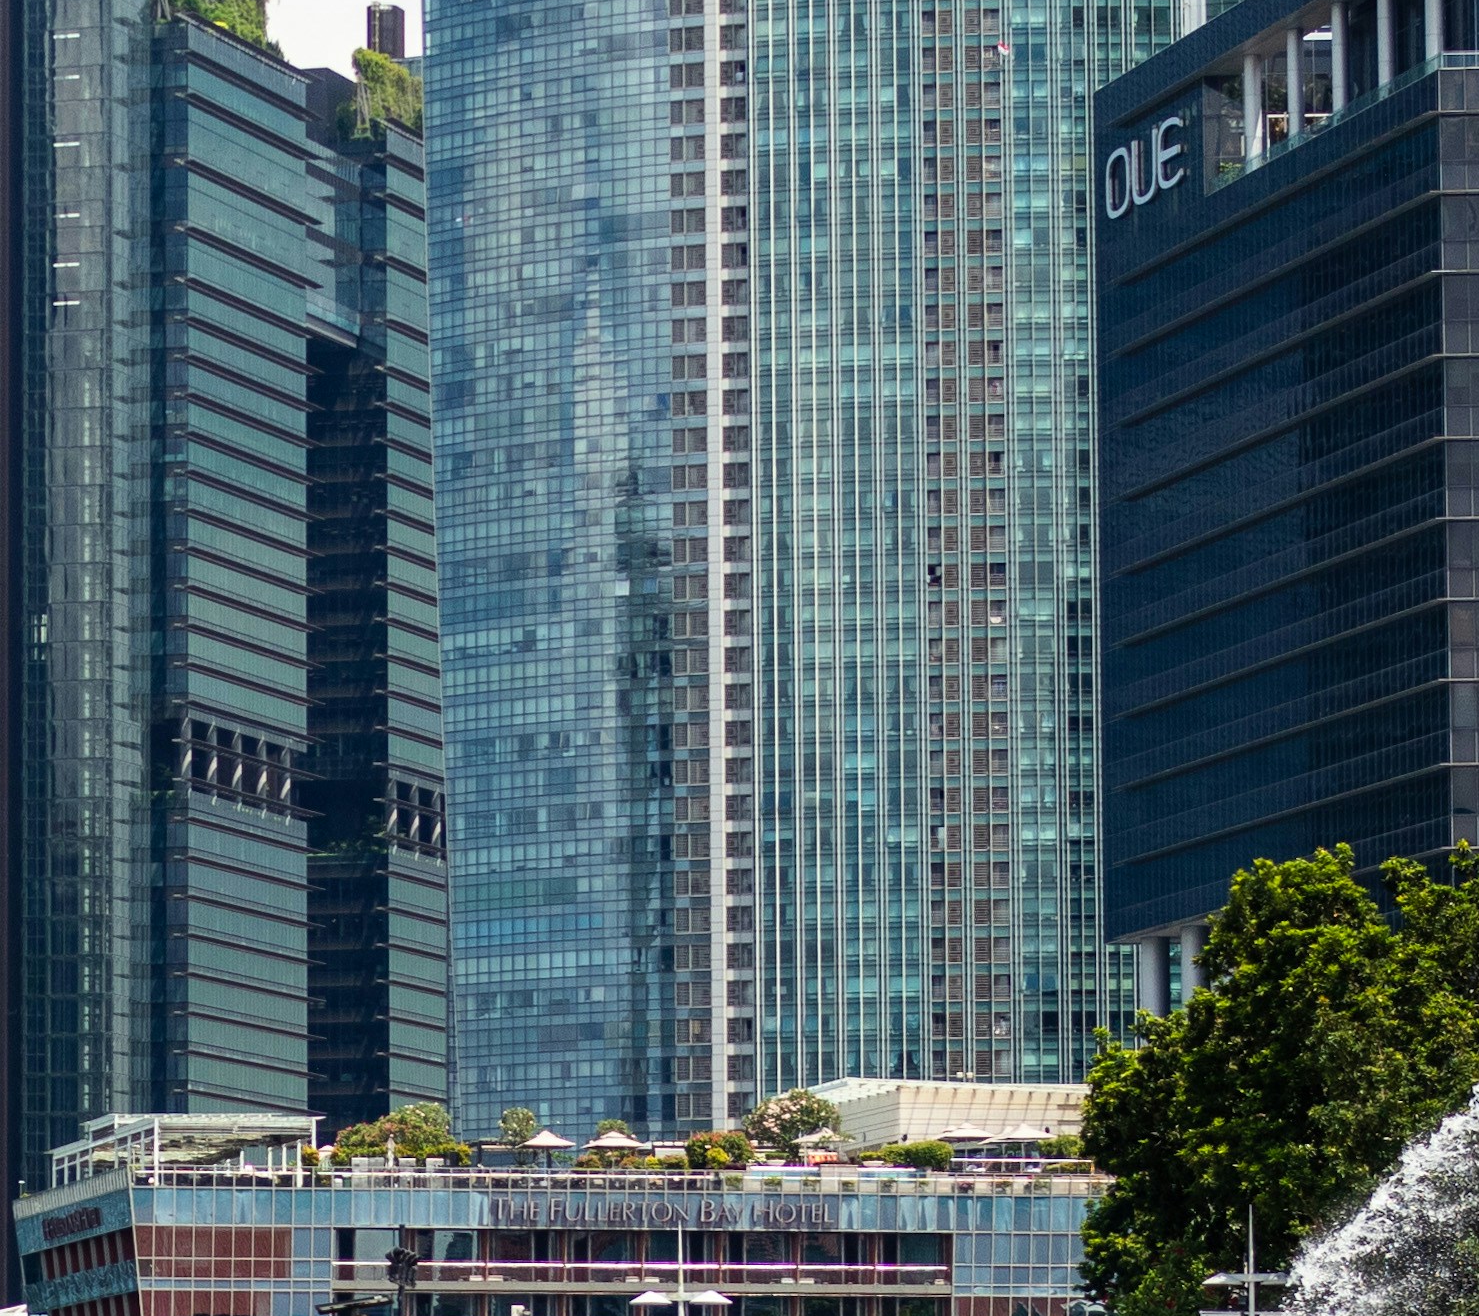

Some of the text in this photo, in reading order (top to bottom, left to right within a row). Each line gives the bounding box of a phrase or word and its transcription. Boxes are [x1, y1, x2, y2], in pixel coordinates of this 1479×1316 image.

[1105, 116, 1185, 220] OUE
[492, 1197, 835, 1223] THE FULLERTON BAY HOTEL
